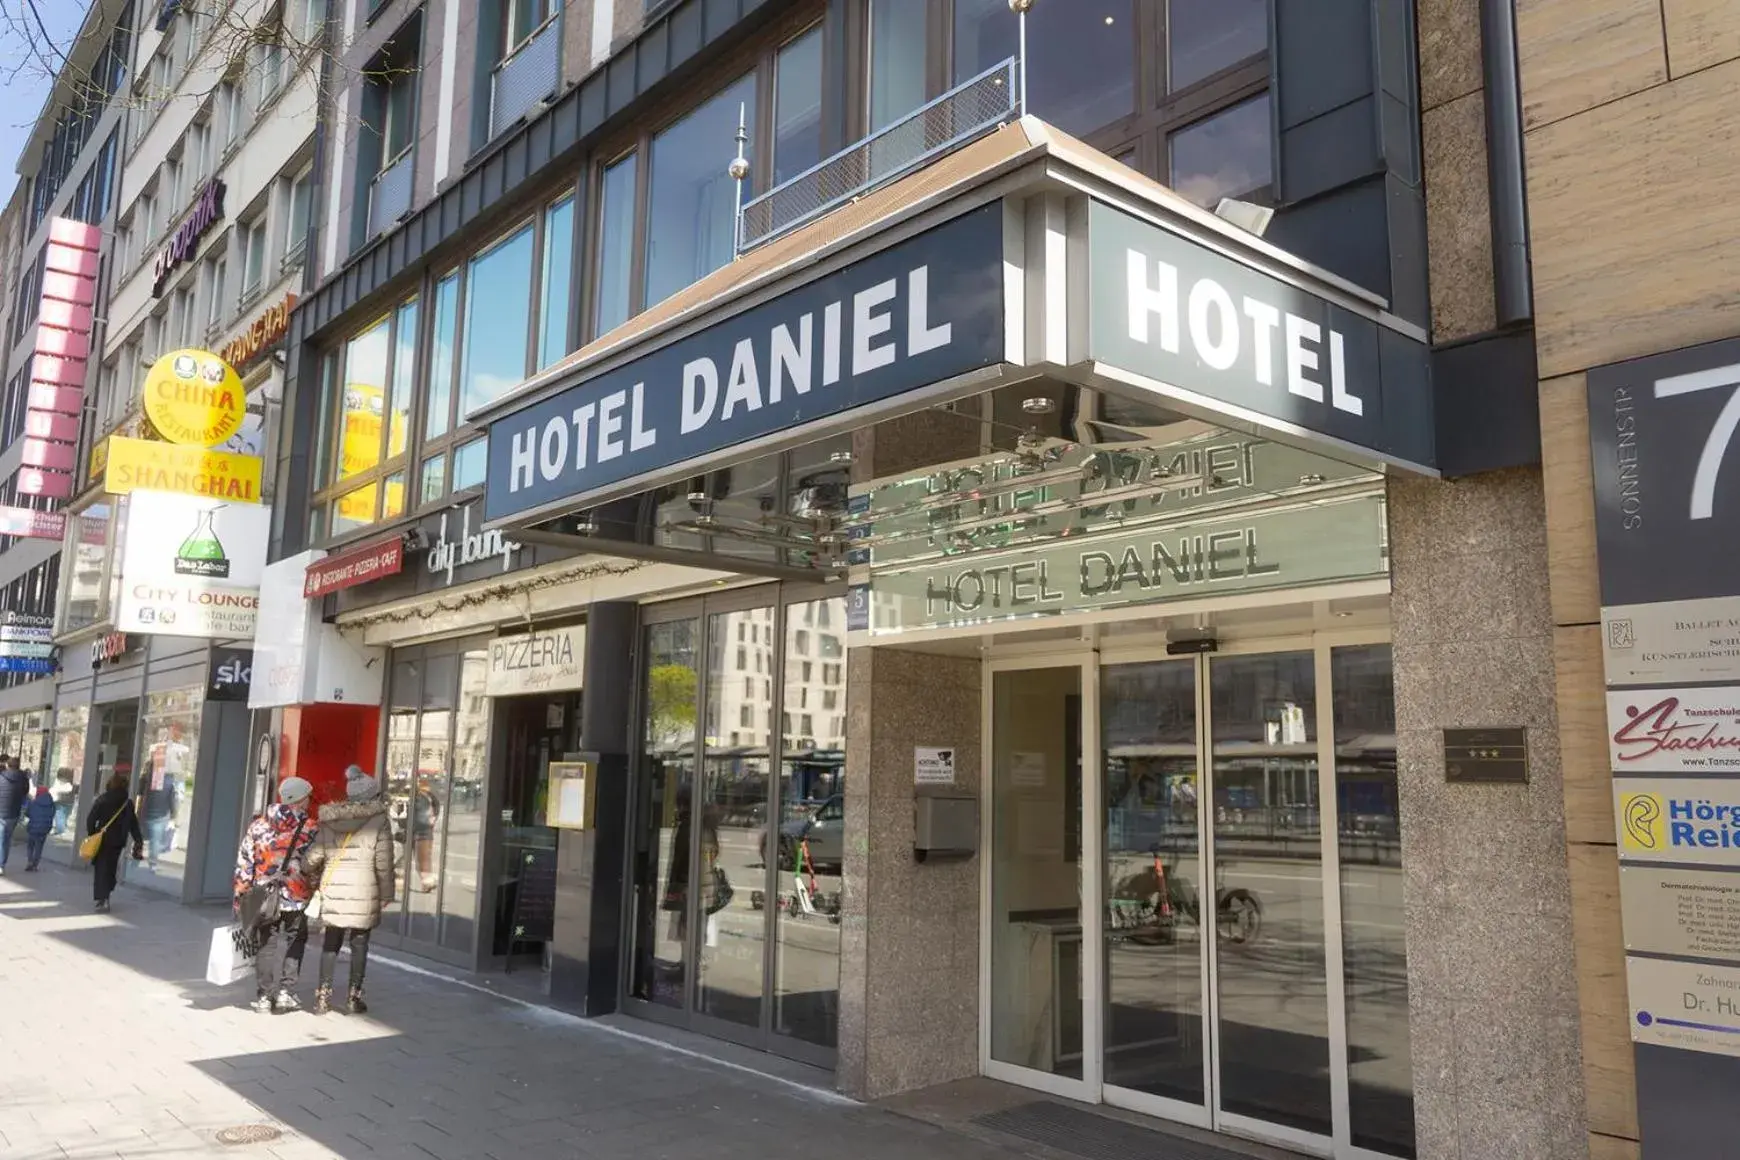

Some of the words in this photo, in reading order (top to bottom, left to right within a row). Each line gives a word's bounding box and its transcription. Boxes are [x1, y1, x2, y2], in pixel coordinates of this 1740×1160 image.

[1127, 248, 1363, 417] HOTEL
[157, 378, 236, 411] CHINA
[509, 382, 656, 493] HOTEL
[680, 265, 952, 435] DANIEL
[1654, 363, 1740, 521] 7
[117, 464, 253, 499] SHANGHAI
[926, 558, 1062, 616] HOTEL
[1079, 526, 1281, 598] DANIEL
[491, 632, 573, 673] PIZZERIA
[216, 661, 250, 686] sk
[1683, 991, 1711, 1013] Dr.
